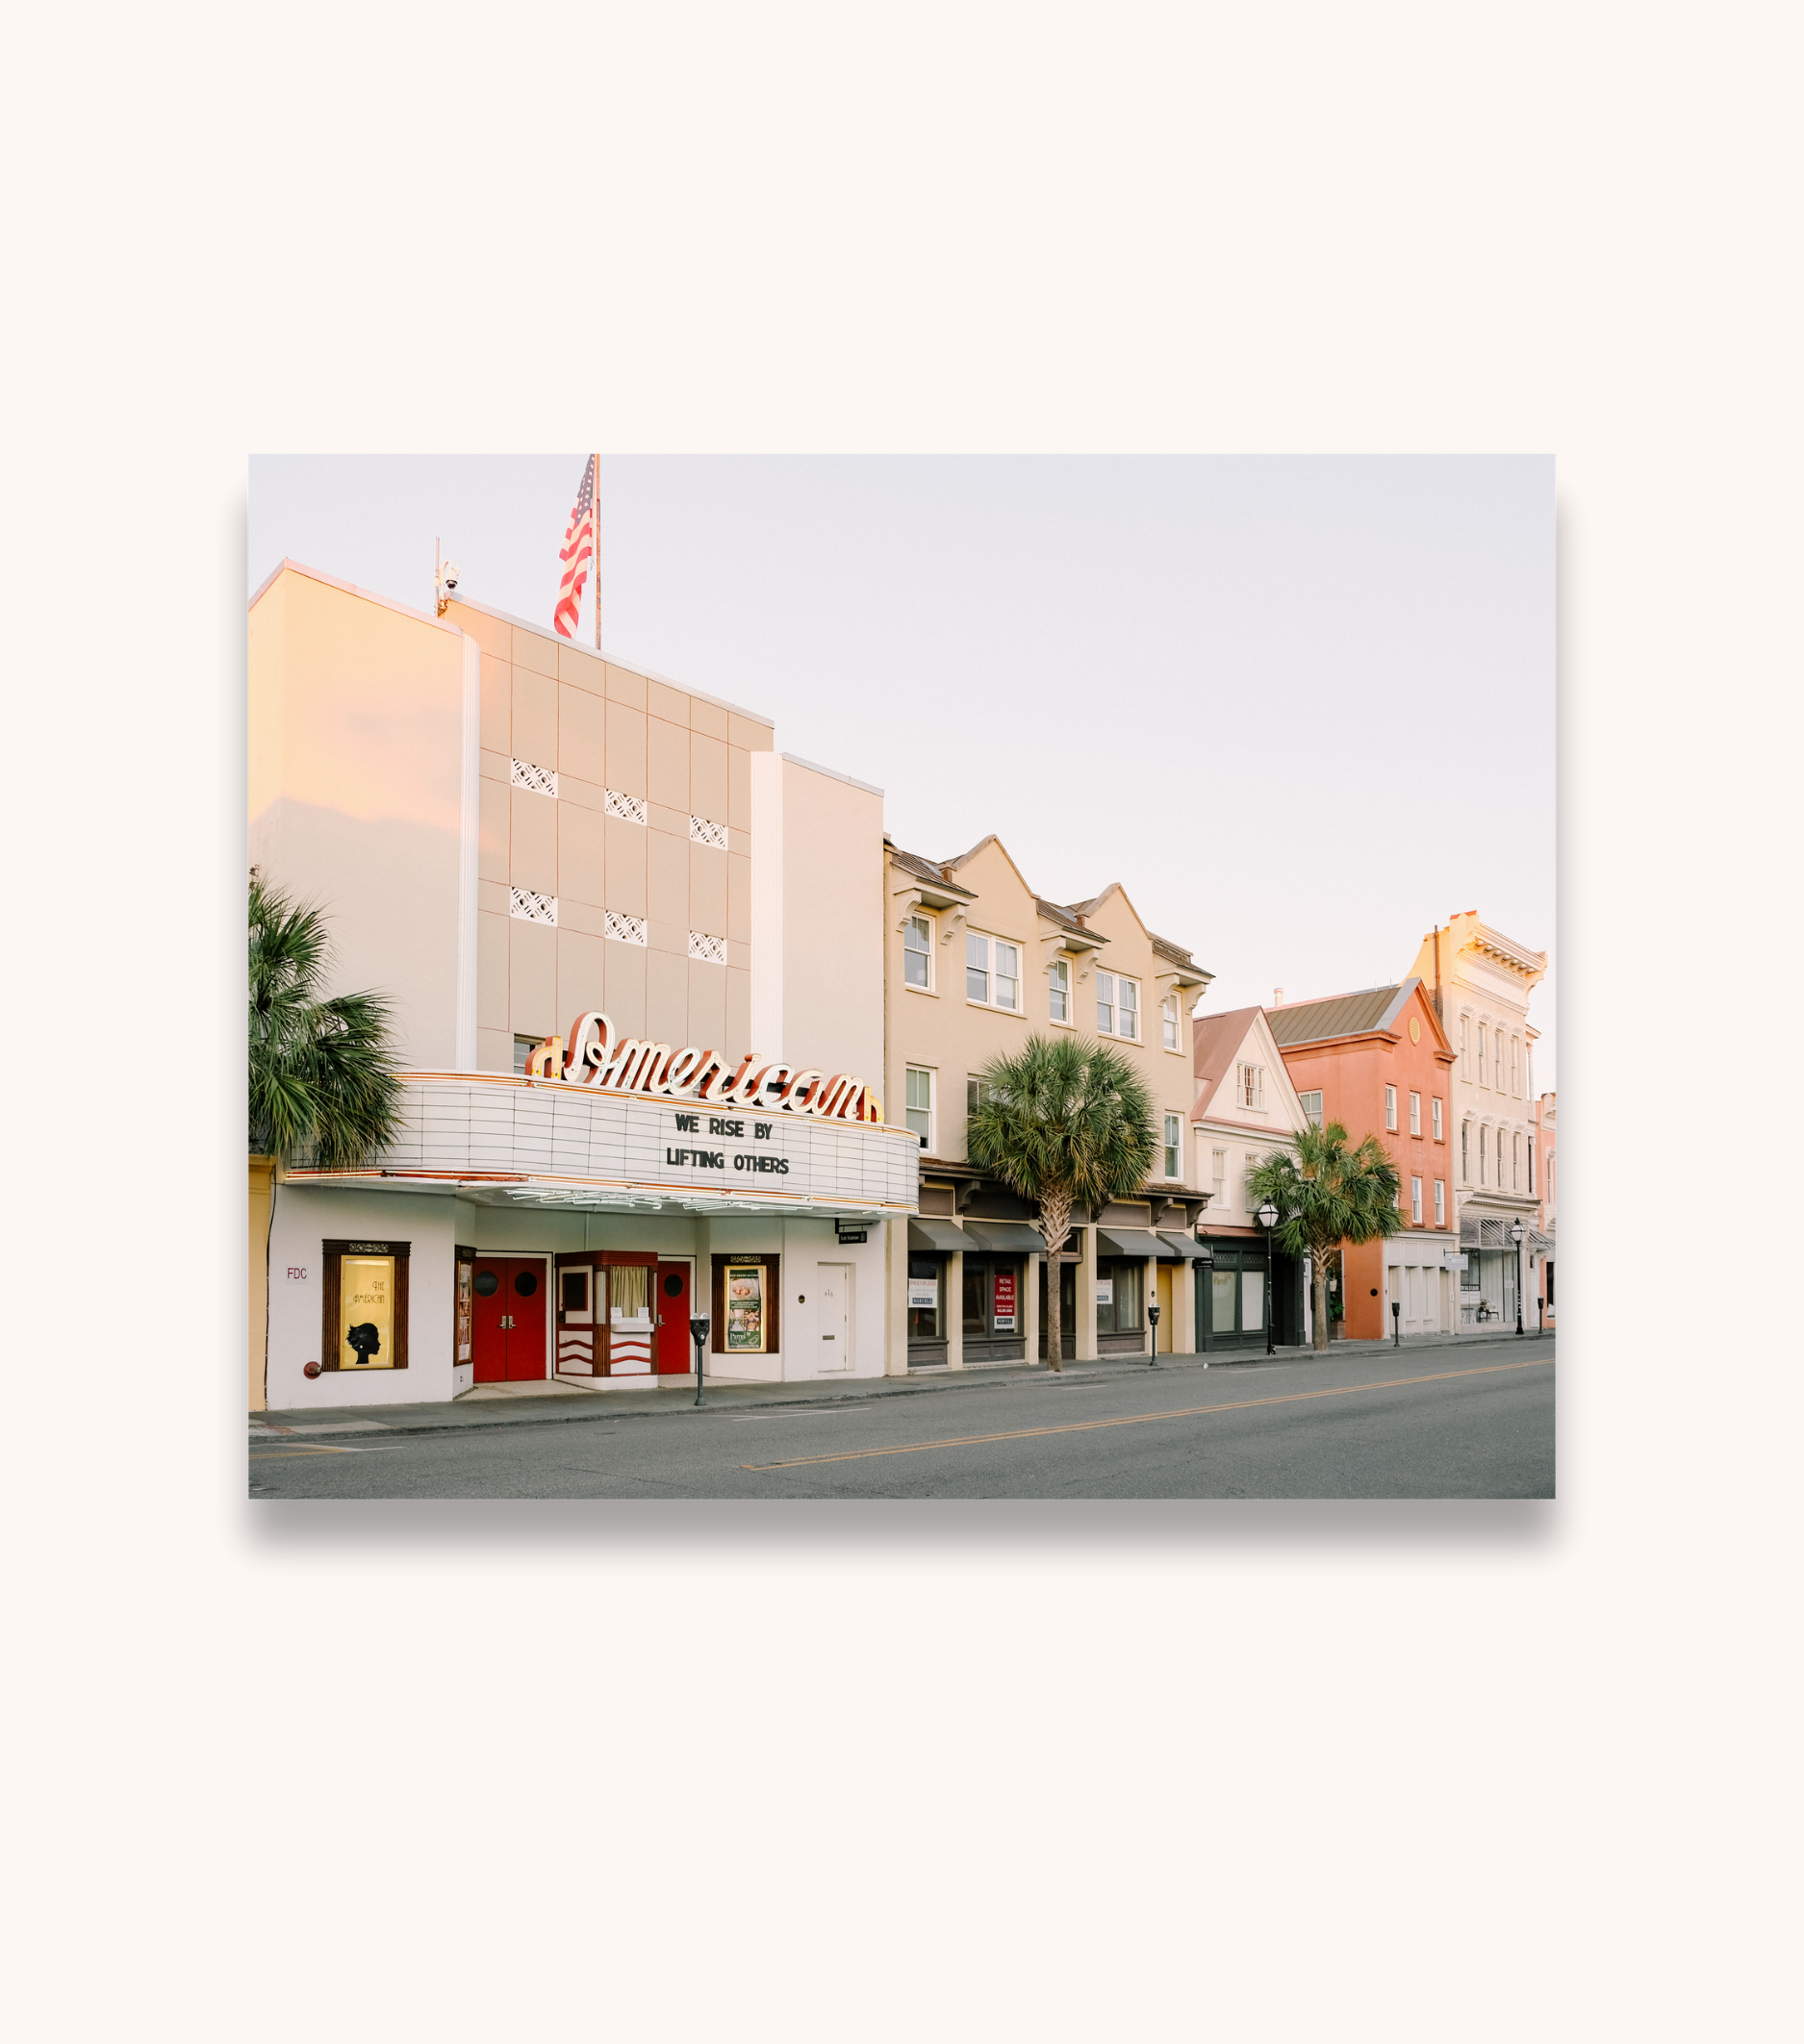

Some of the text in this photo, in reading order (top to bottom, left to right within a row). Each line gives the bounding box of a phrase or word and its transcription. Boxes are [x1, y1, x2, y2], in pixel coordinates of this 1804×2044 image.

[563, 1011, 863, 1120] American
[675, 1113, 774, 1140] WE RISE BY
[667, 1147, 789, 1174] LIFTING OTHERS
[287, 1267, 308, 1279] FDC
